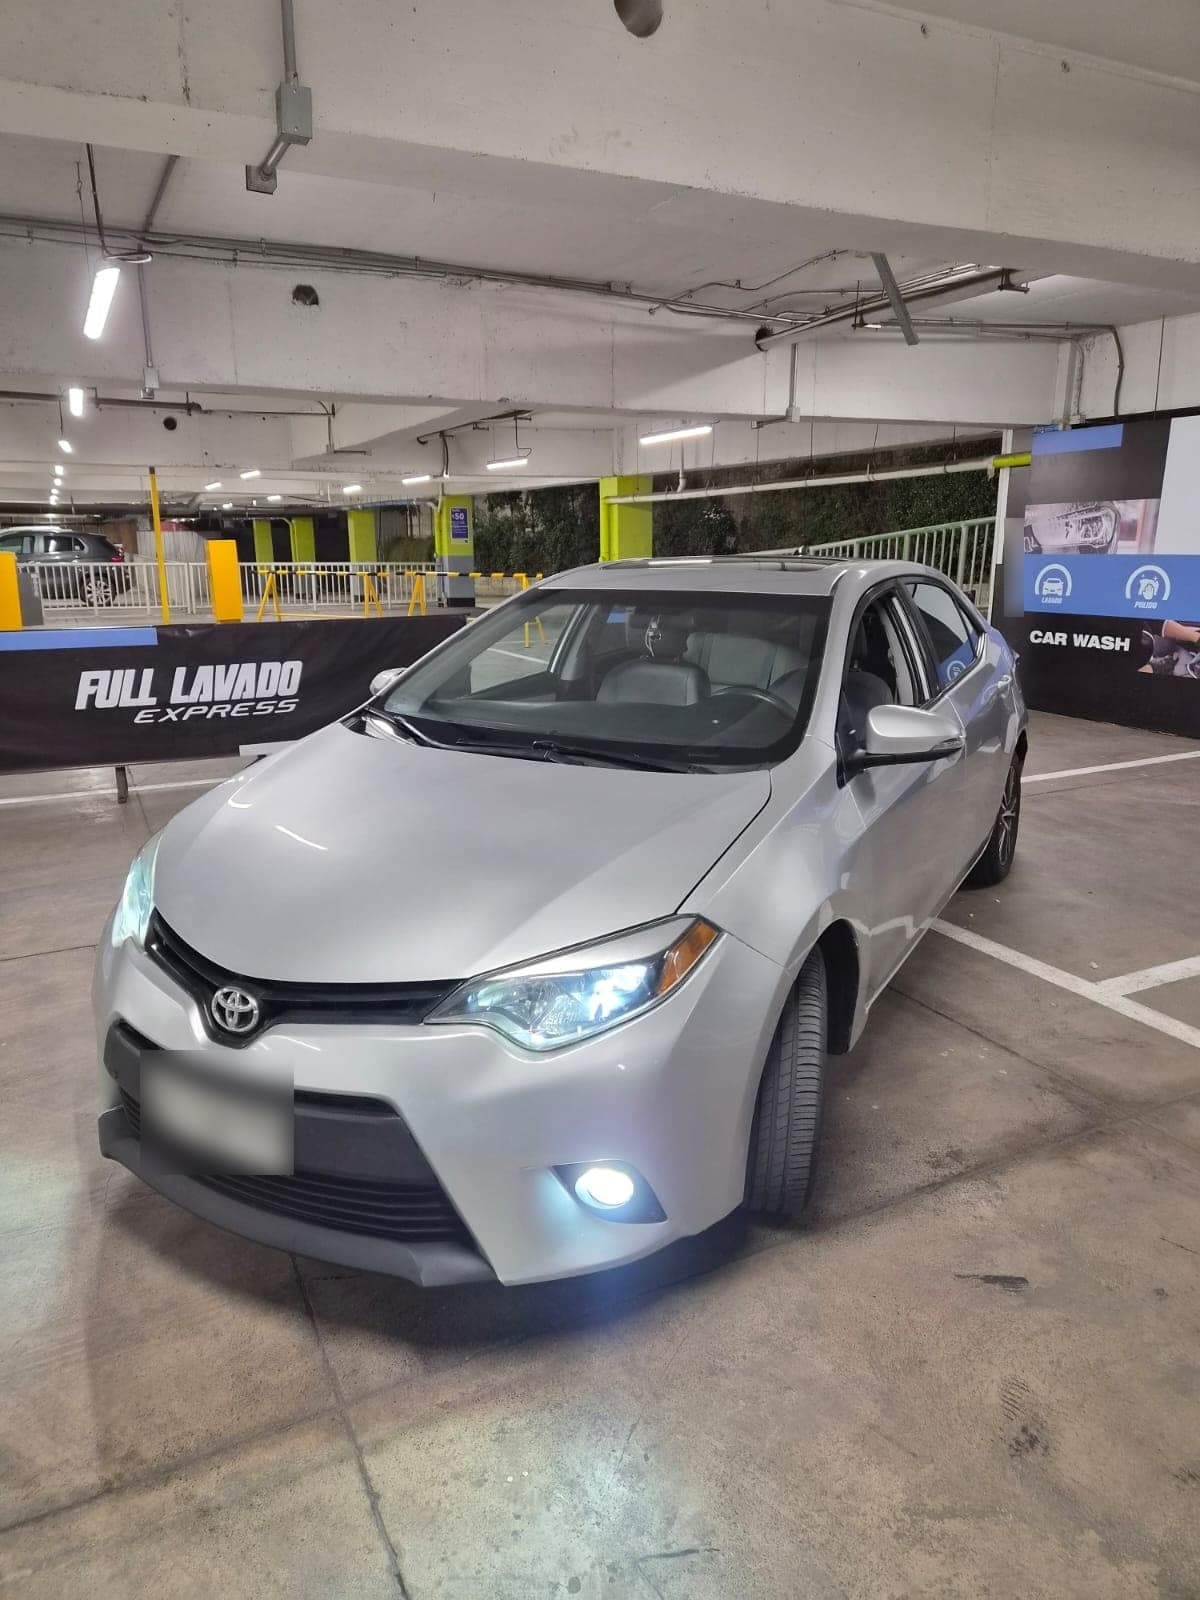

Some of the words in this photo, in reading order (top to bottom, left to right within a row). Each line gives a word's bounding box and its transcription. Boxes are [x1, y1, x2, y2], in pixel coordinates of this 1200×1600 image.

[1029, 630, 1068, 646] CAR
[1073, 633, 1131, 652] WASH
[75, 669, 157, 710] FULL
[169, 660, 303, 704] LAVADO
[133, 698, 300, 724] EXPRESS
